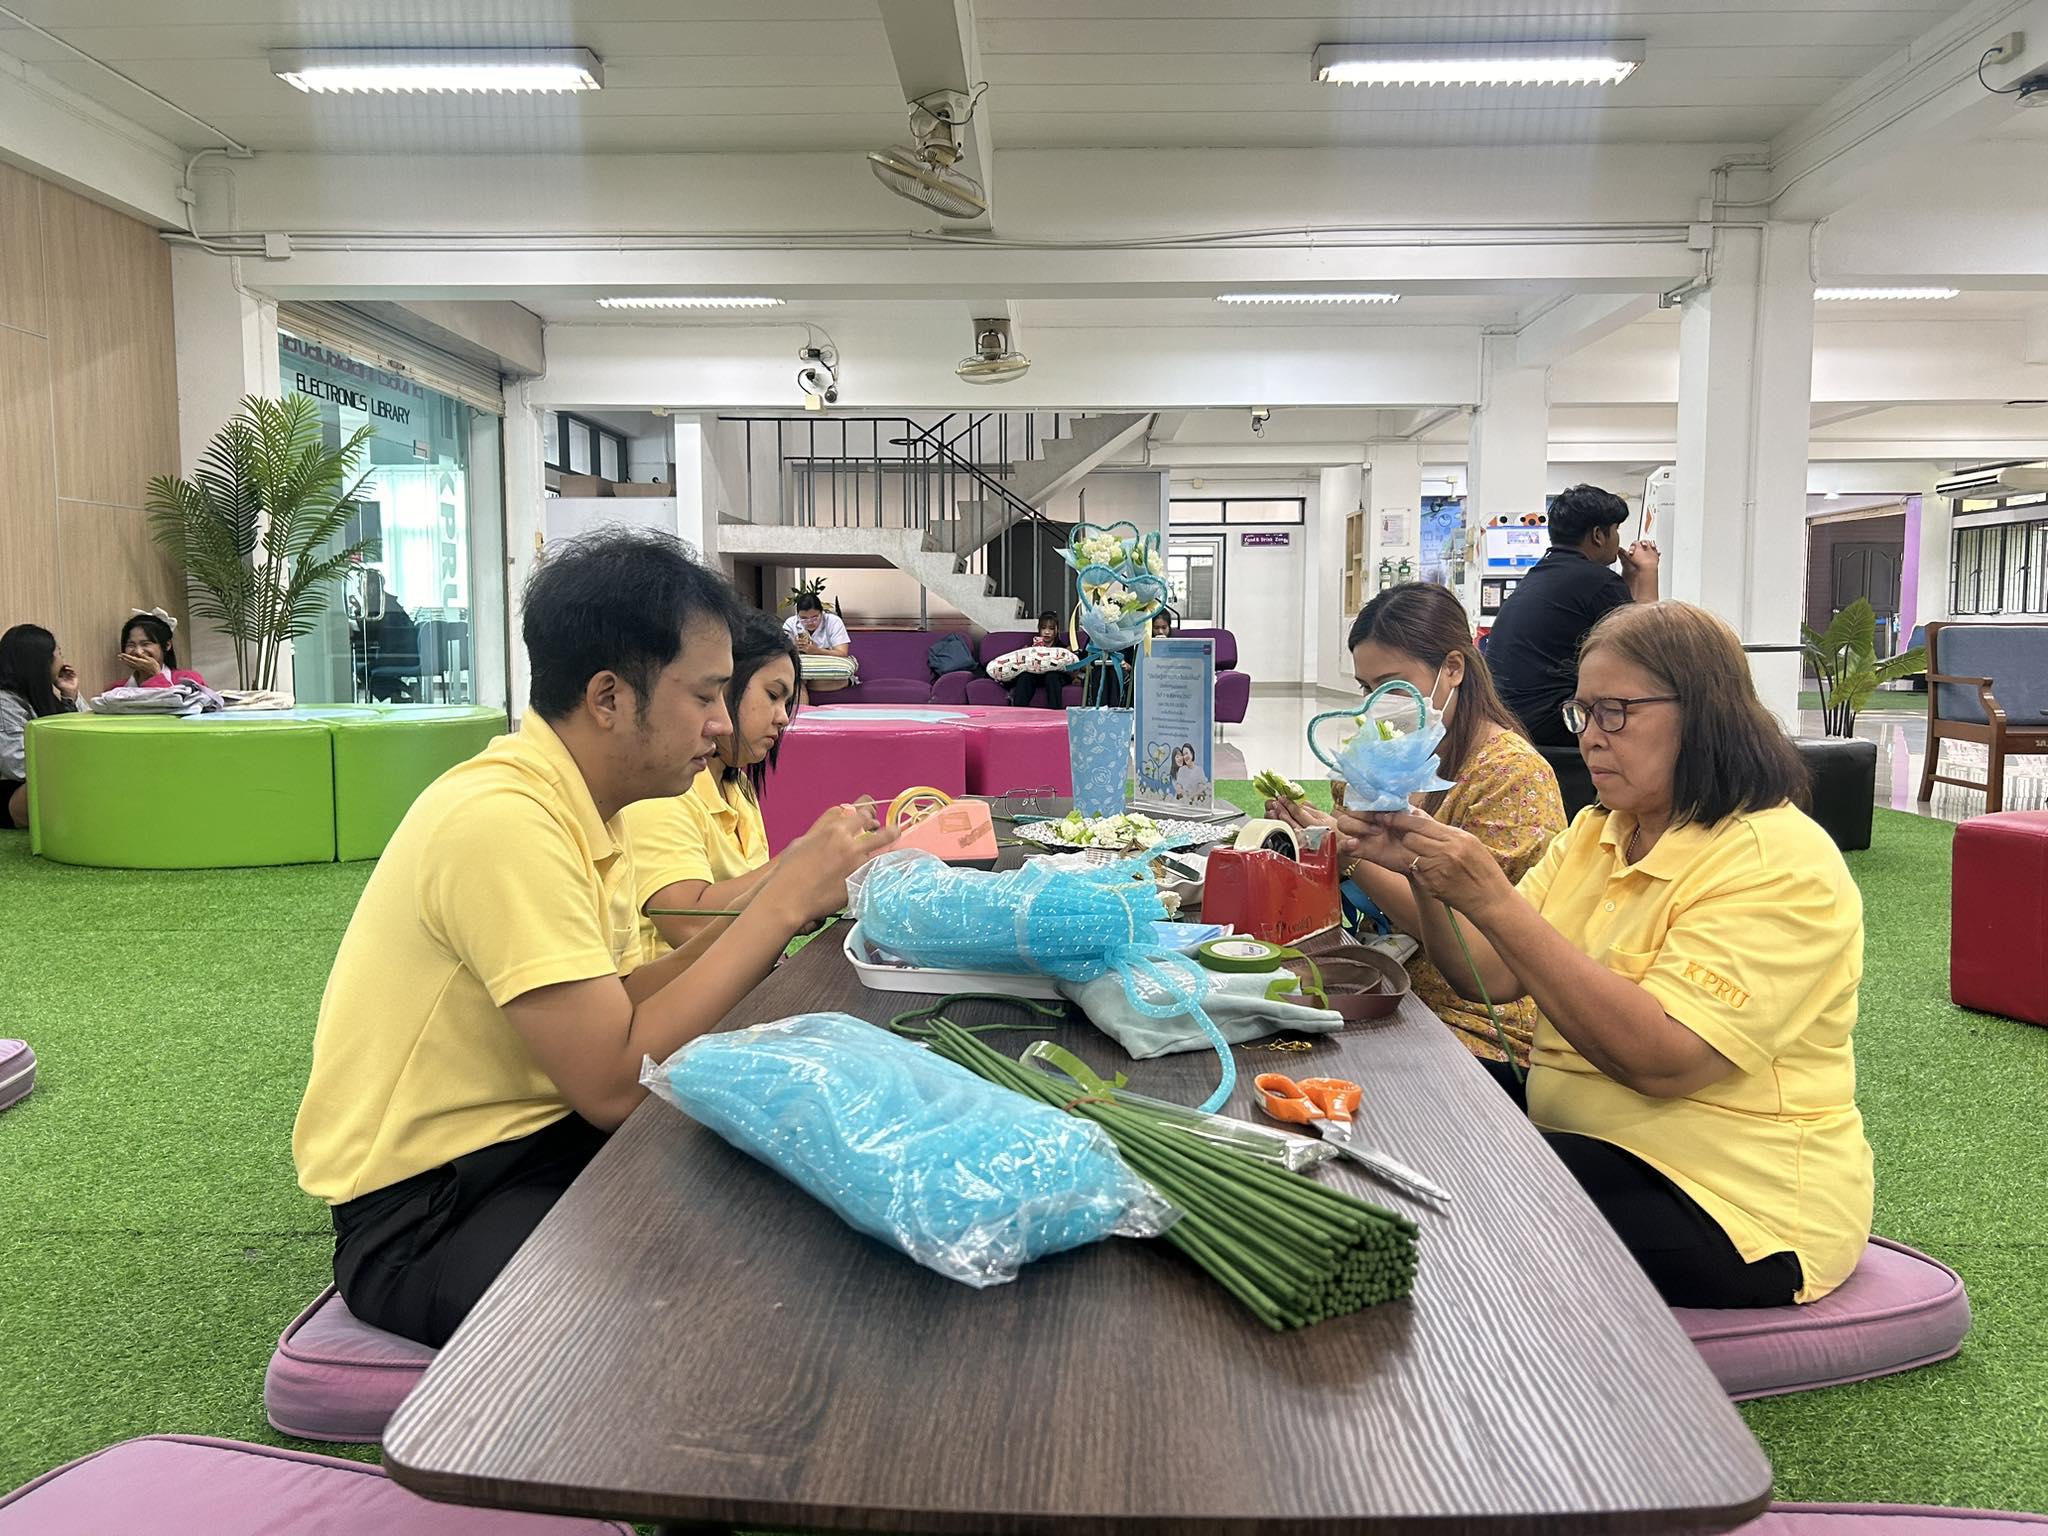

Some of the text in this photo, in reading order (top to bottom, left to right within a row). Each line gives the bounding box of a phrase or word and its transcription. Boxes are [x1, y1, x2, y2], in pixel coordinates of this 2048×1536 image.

[296, 372, 411, 424] ELECTRONICS LIBRARY
[1682, 961, 1751, 1009] KPRU
